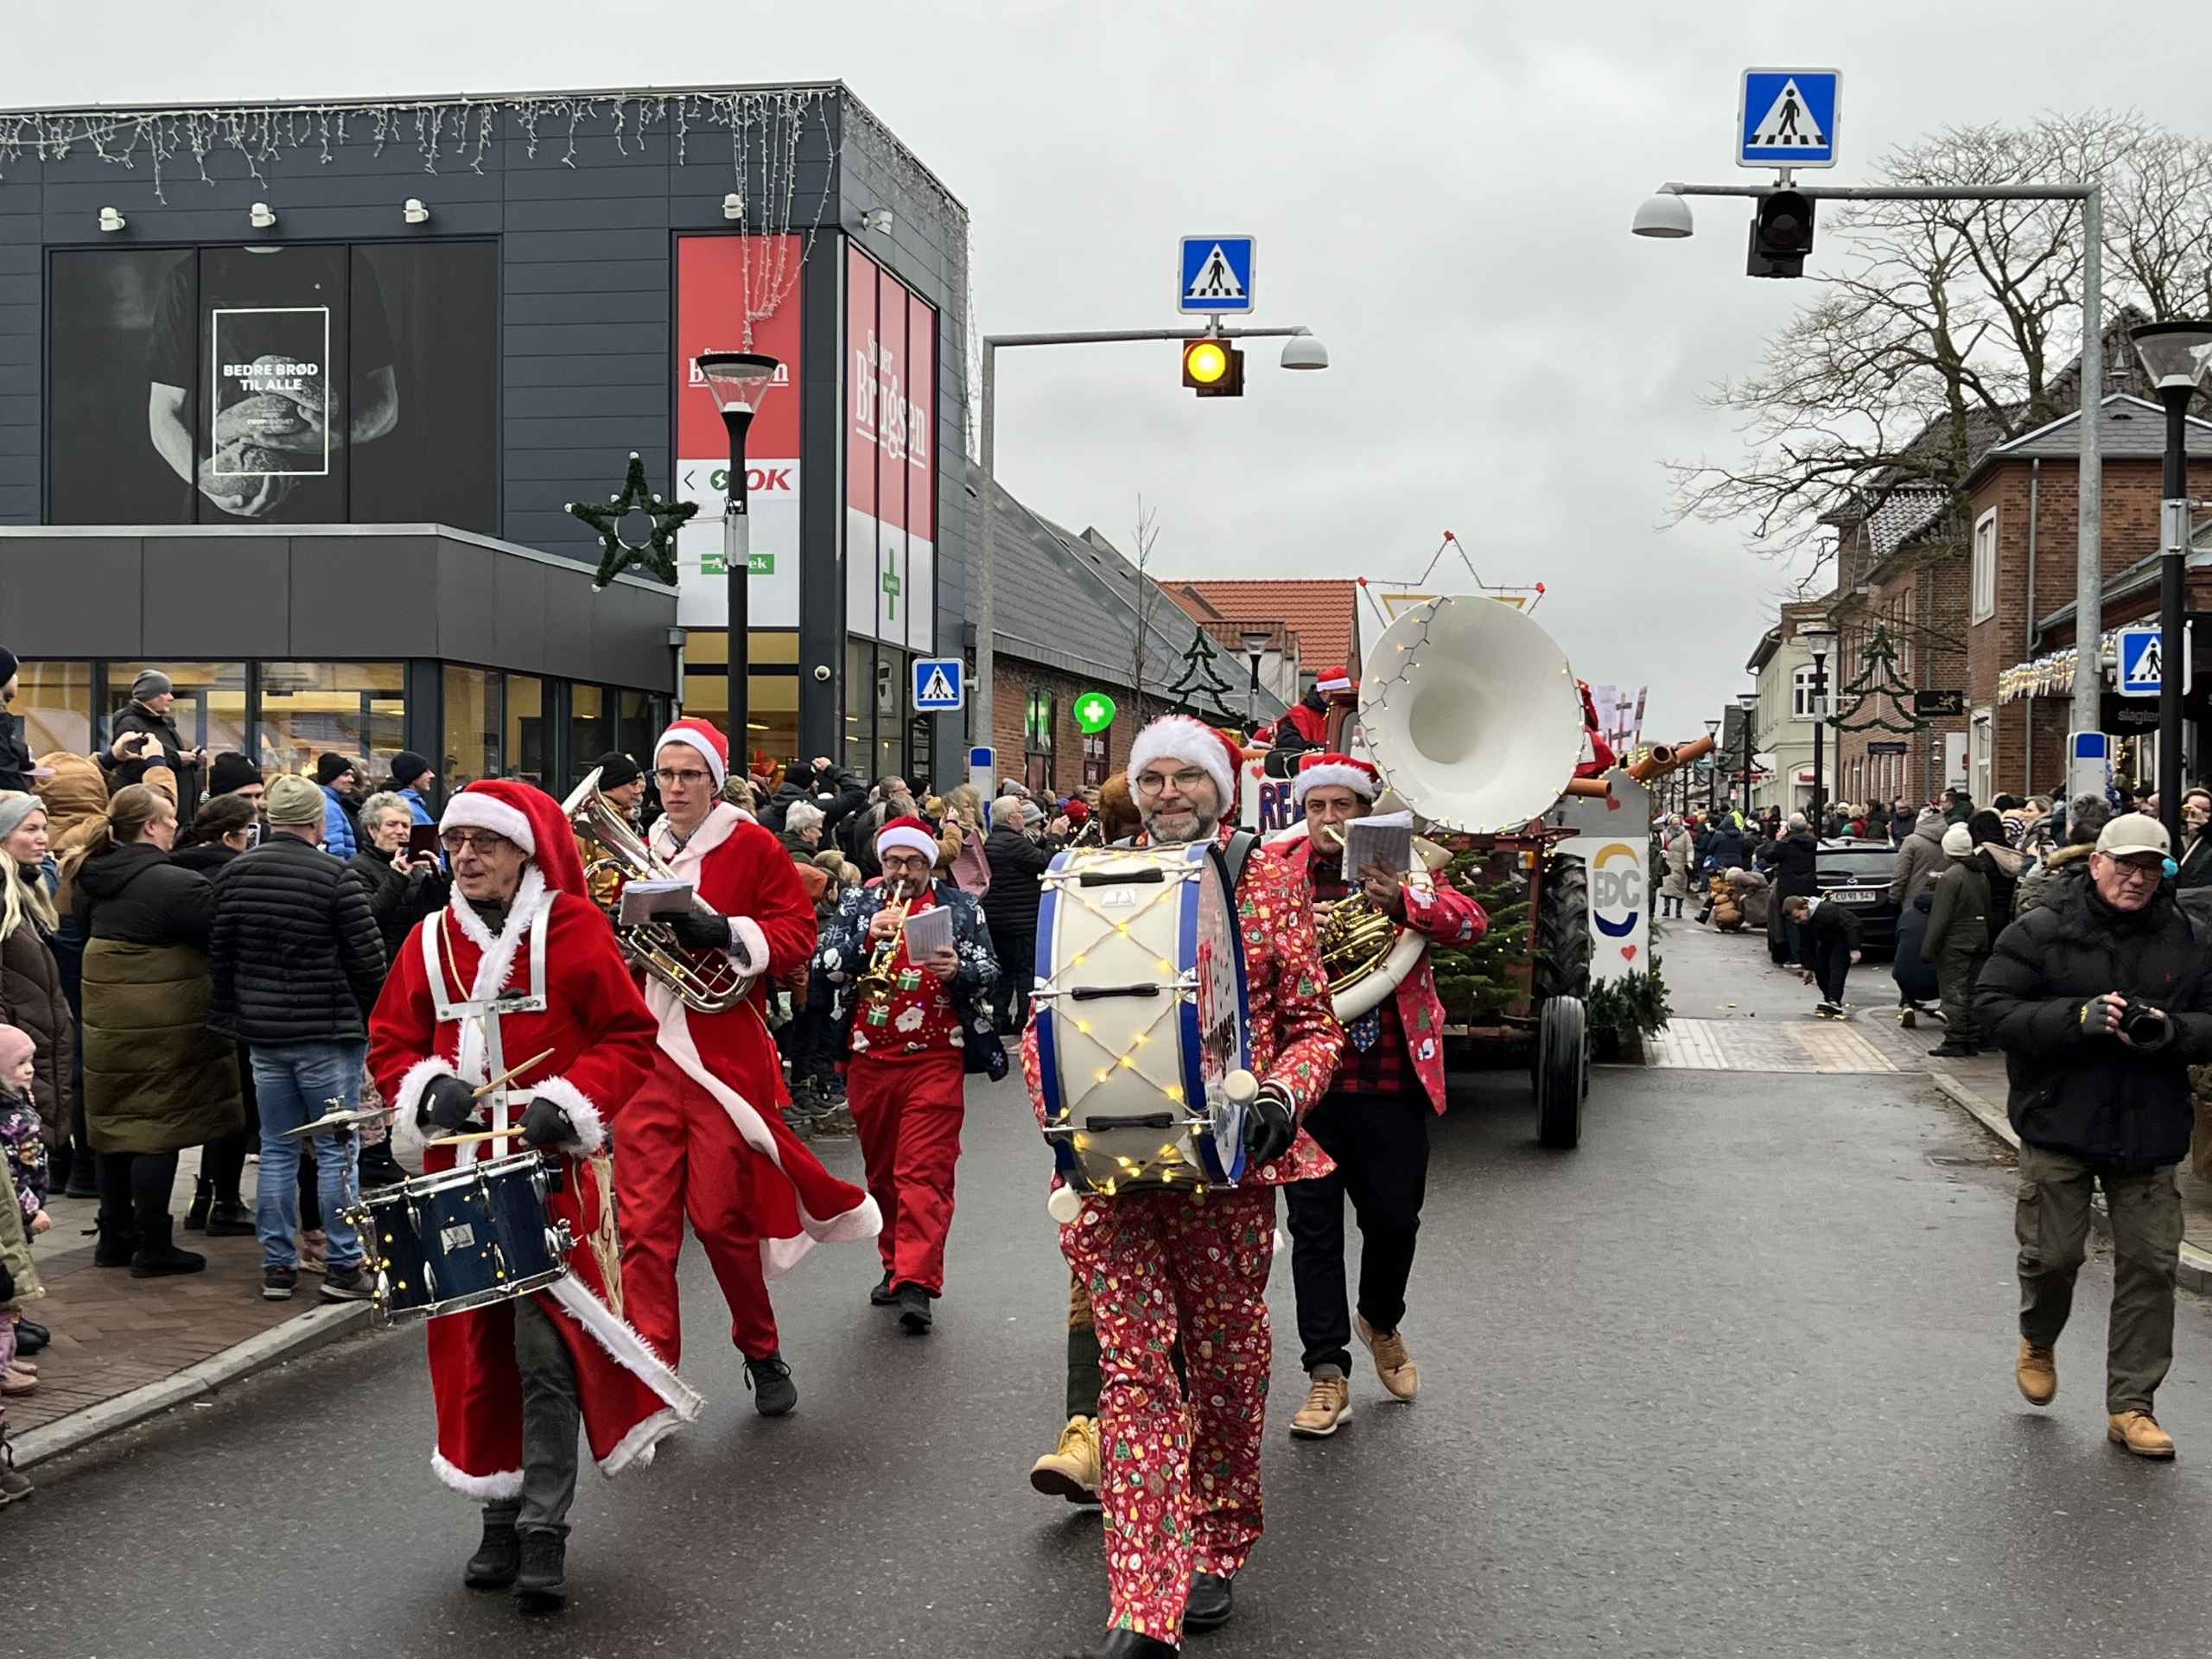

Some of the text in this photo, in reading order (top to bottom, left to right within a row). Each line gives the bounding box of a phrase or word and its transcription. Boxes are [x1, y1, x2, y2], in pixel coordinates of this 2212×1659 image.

[223, 363, 319, 377] BEDRE BRØD
[239, 378, 303, 391] TIL ALLE
[855, 349, 926, 460] Brugsen
[746, 468, 793, 491] OK
[1592, 869, 1641, 908] EDC
